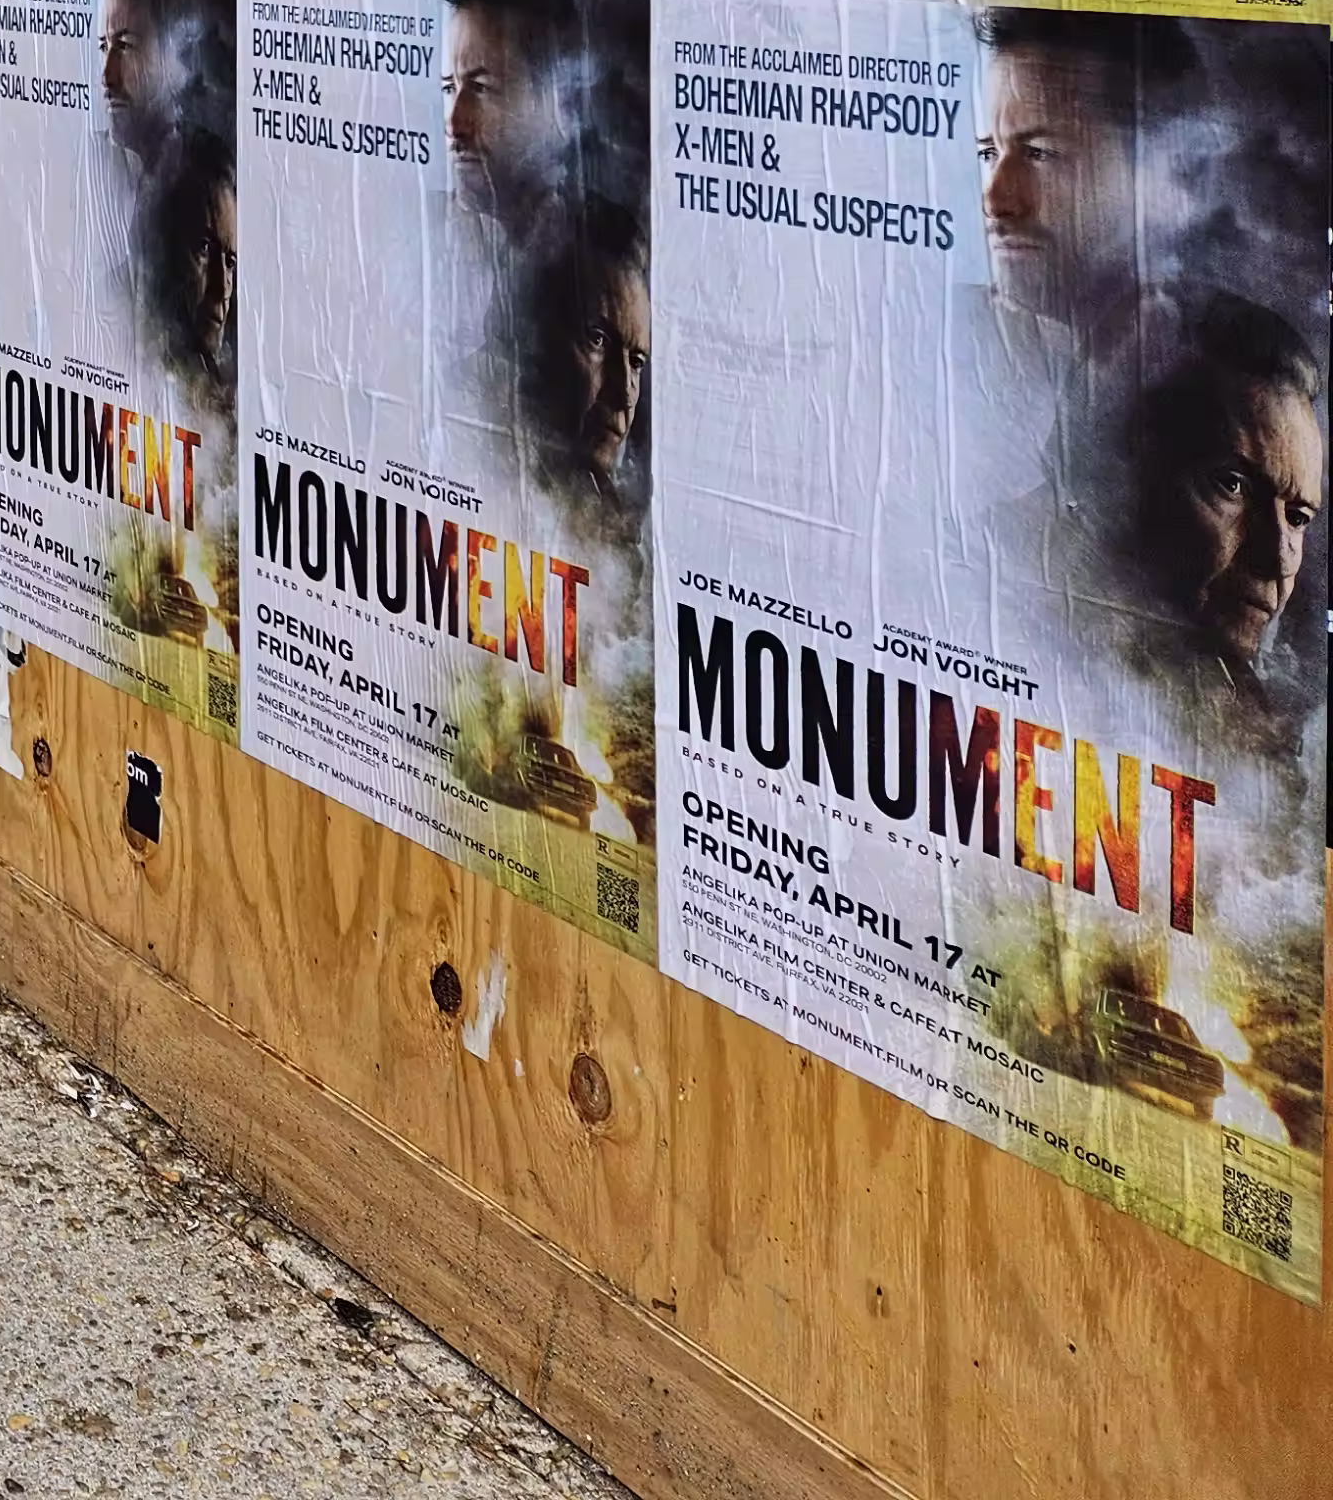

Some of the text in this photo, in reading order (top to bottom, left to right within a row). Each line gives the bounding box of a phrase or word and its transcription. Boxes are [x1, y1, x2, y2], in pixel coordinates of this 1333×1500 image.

[253, 67, 321, 107] X-MEN &
[677, 175, 953, 253] THE USUAL SUSPECTS
[33, 530, 79, 568] APRIL
[83, 553, 101, 578] 17
[254, 453, 590, 694] MONUMENT
[257, 601, 353, 663] OPENING
[678, 607, 1214, 945] MONUMENT
[682, 790, 829, 878] OPENING
